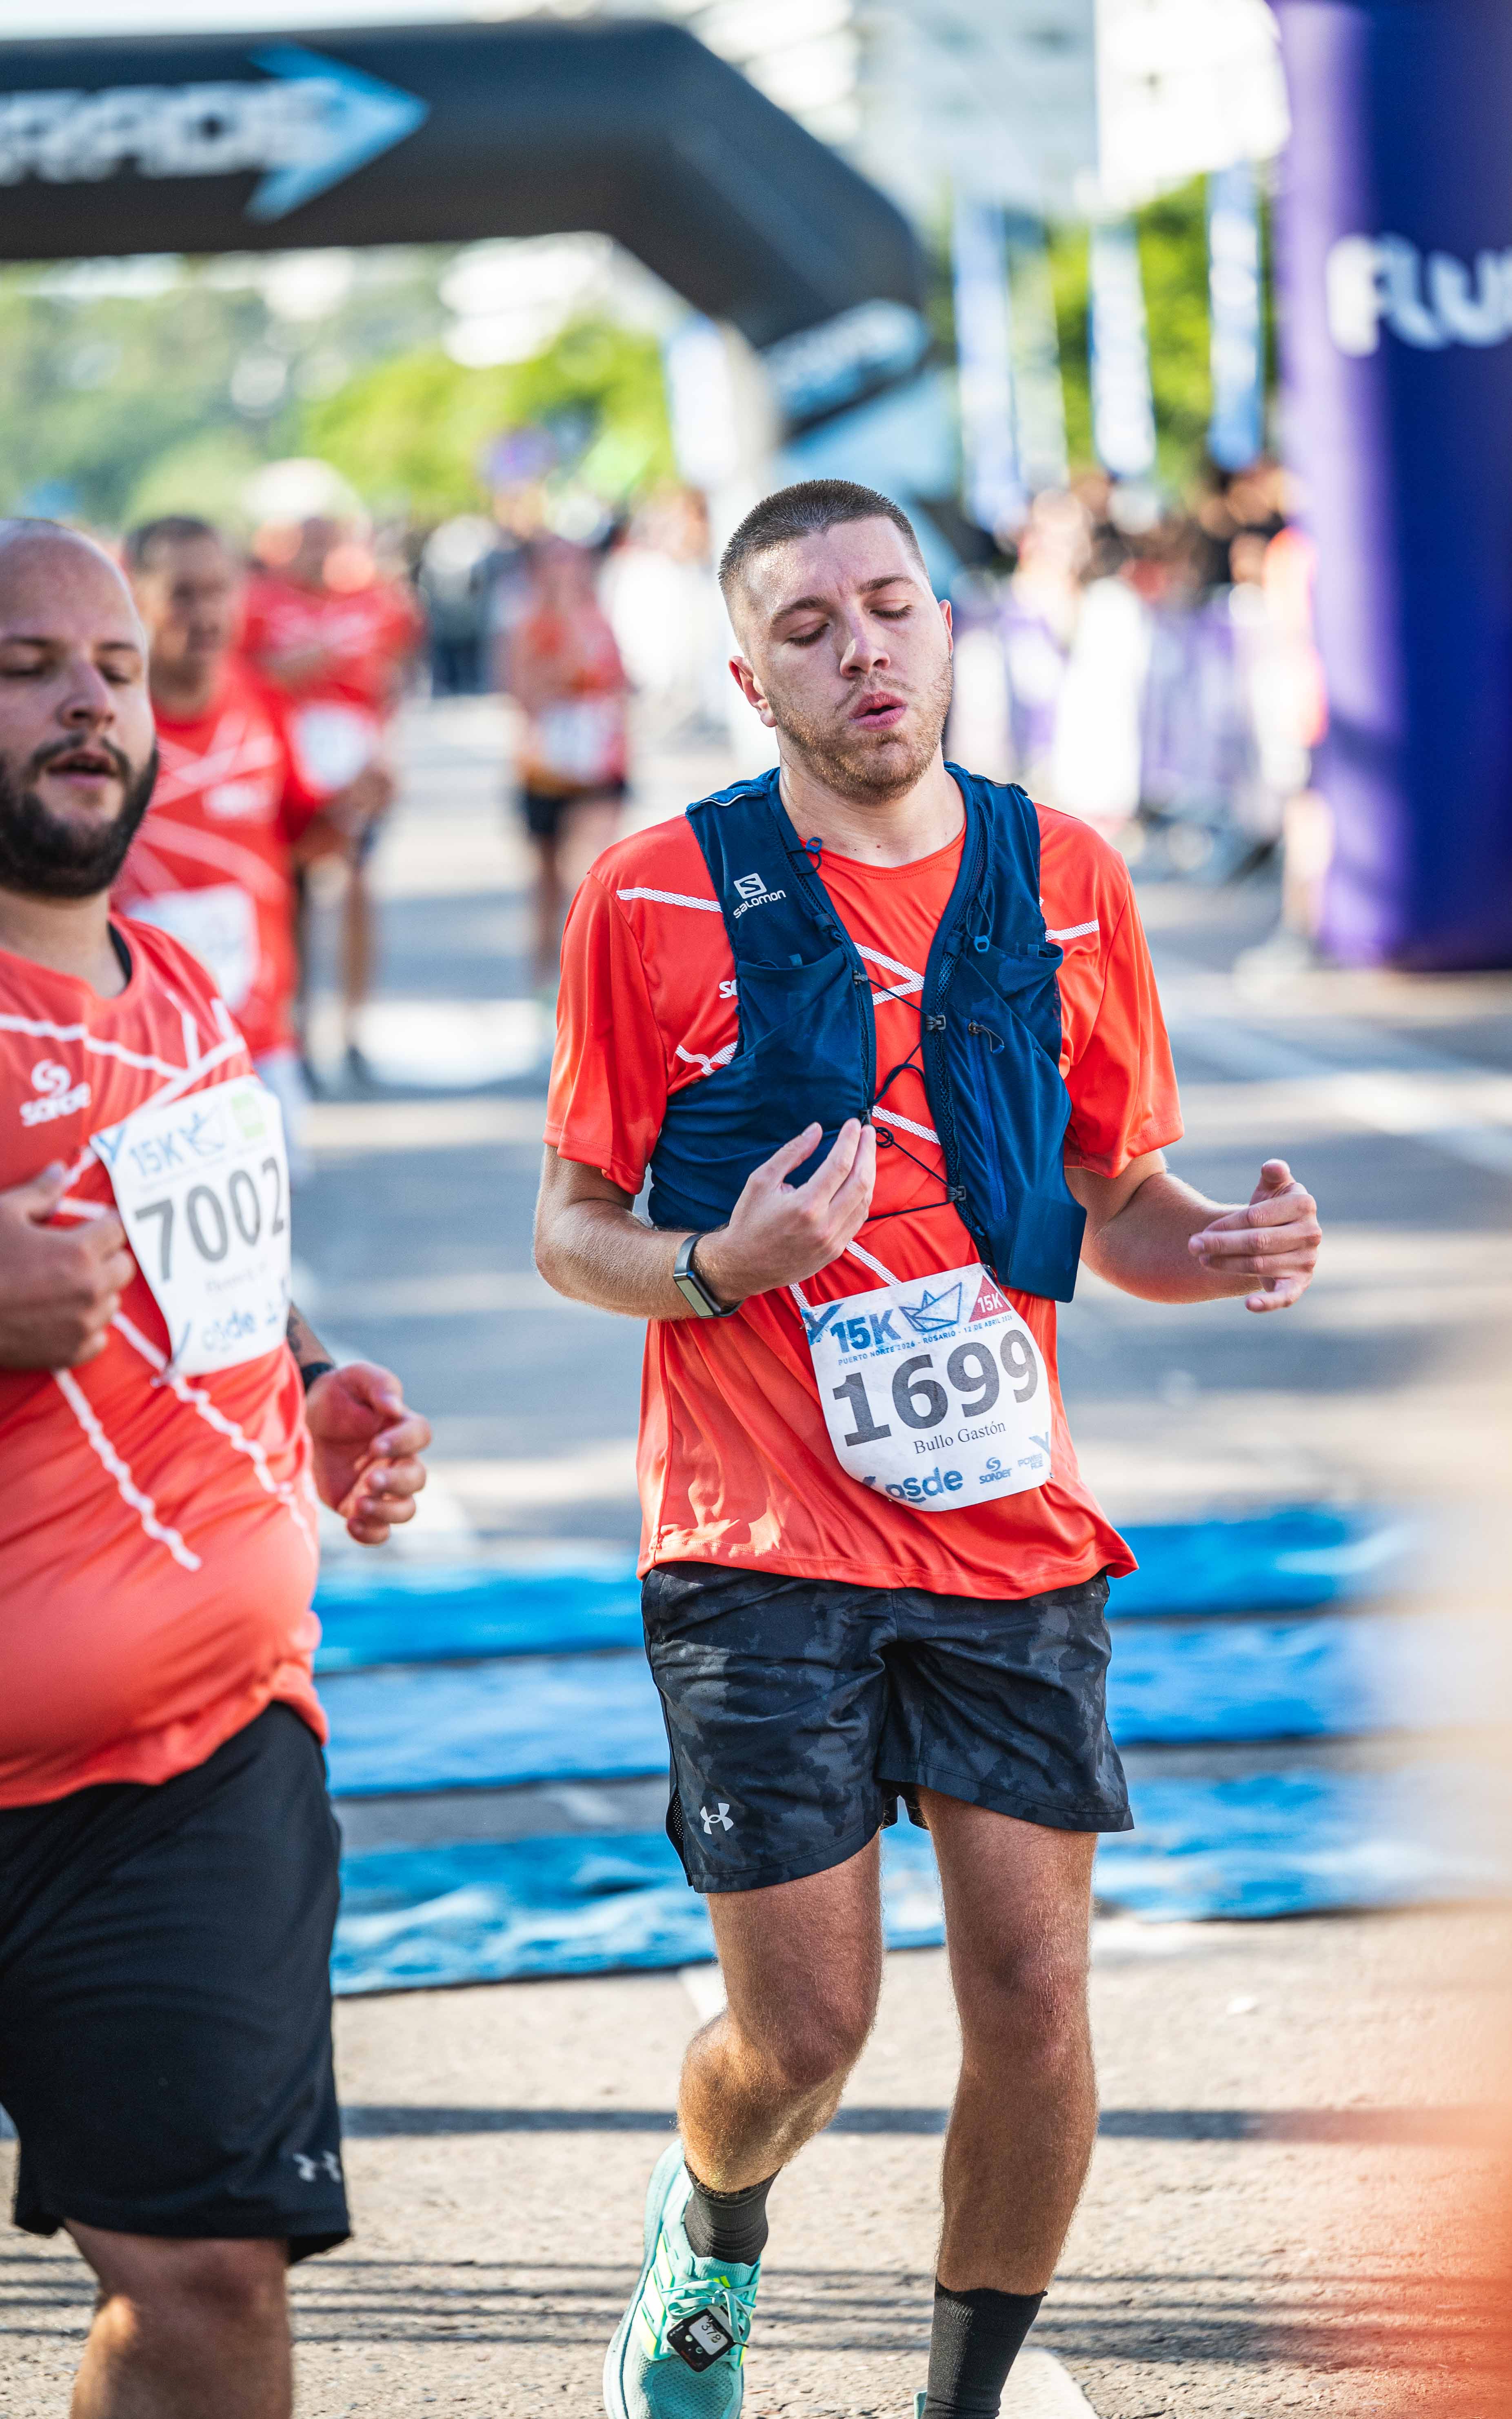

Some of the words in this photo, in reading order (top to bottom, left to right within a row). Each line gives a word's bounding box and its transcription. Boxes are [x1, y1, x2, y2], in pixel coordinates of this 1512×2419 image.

[129, 1131, 184, 1177] 15K
[134, 1155, 284, 1282] 7002
[977, 1292, 1004, 1313] 15K
[830, 1309, 901, 1353] 15K
[838, 1353, 868, 1366] PUERTO
[870, 1346, 895, 1358] NORTE
[897, 1341, 915, 1351] 2026
[922, 1331, 956, 1344] ROSARIO
[984, 1318, 1001, 1328] ABRIL
[832, 1329, 1038, 1447] 1699
[913, 1434, 954, 1454] Bullo
[957, 1421, 1006, 1442] Gastón
[885, 1466, 964, 1500] osde
